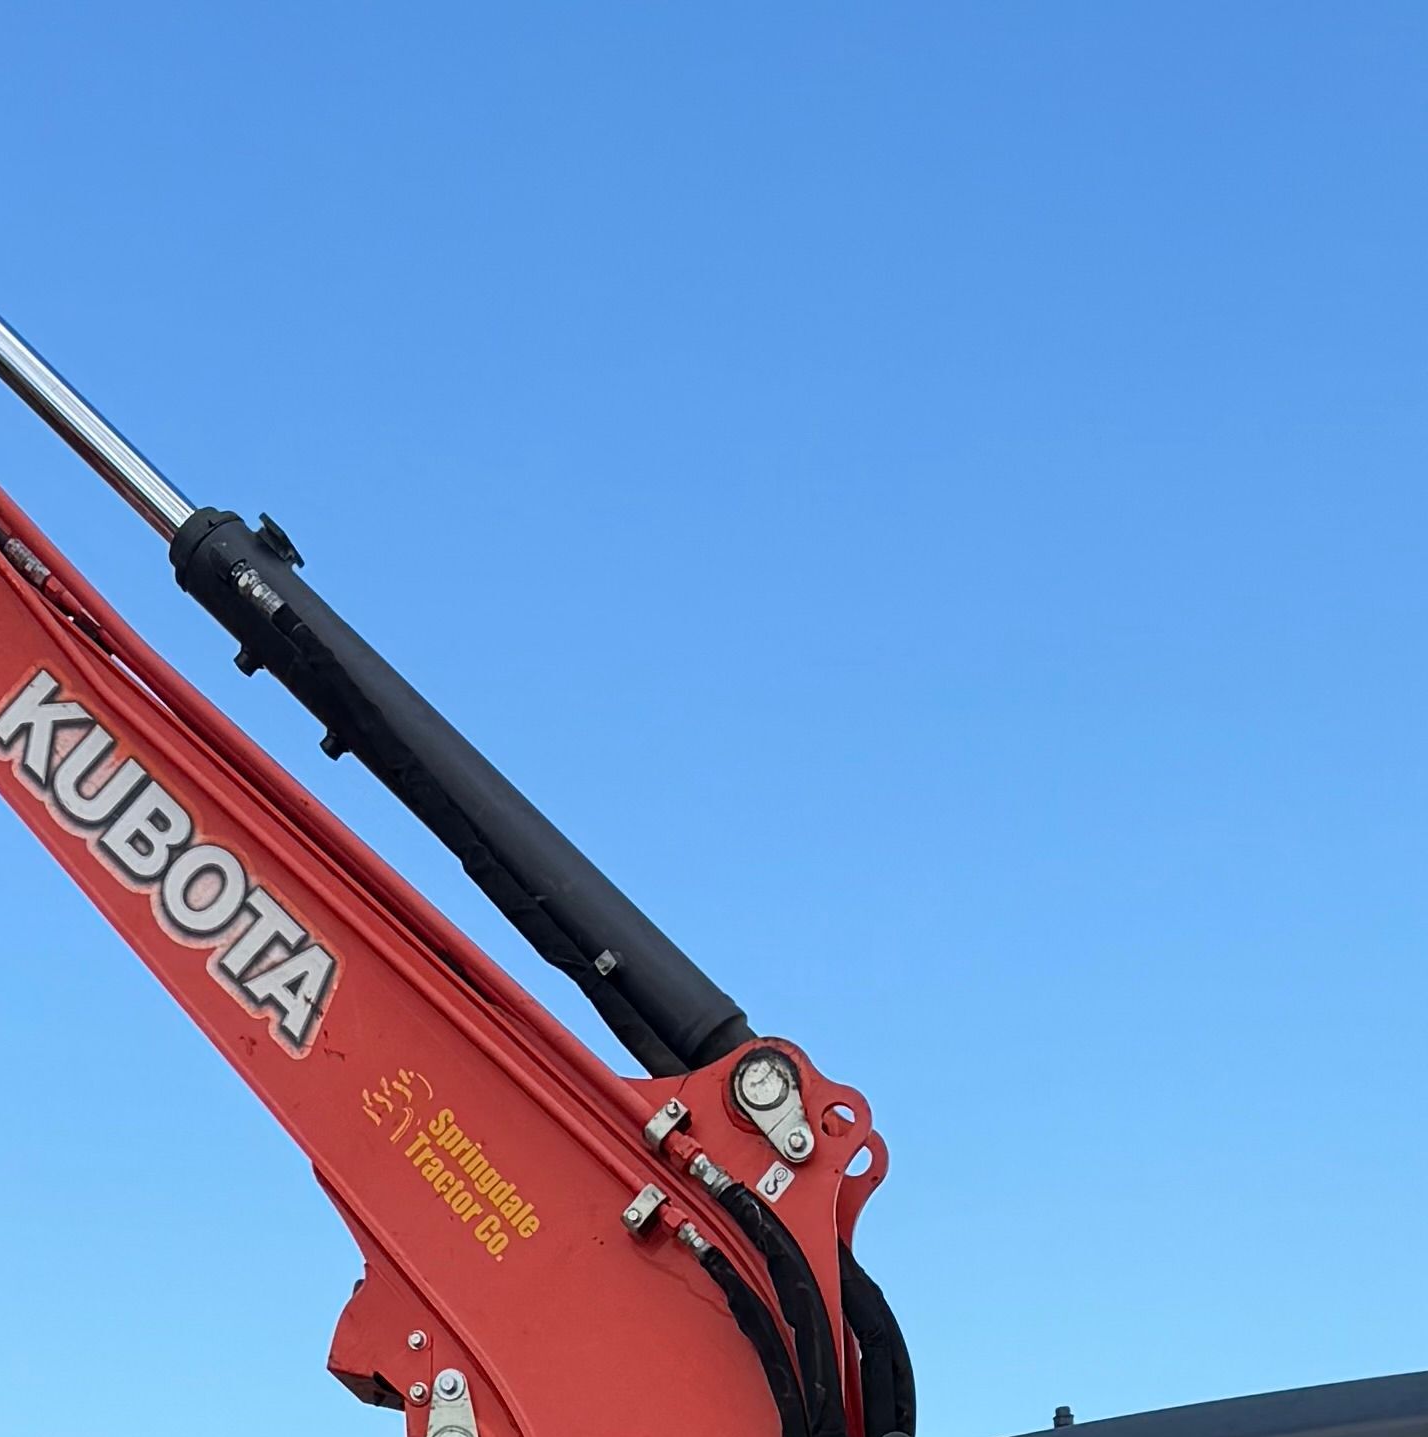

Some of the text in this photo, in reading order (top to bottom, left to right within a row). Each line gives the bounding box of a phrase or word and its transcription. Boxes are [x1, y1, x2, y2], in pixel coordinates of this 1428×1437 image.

[403, 1130, 508, 1263] Tractor Co.
[426, 1105, 541, 1240] Springdale
